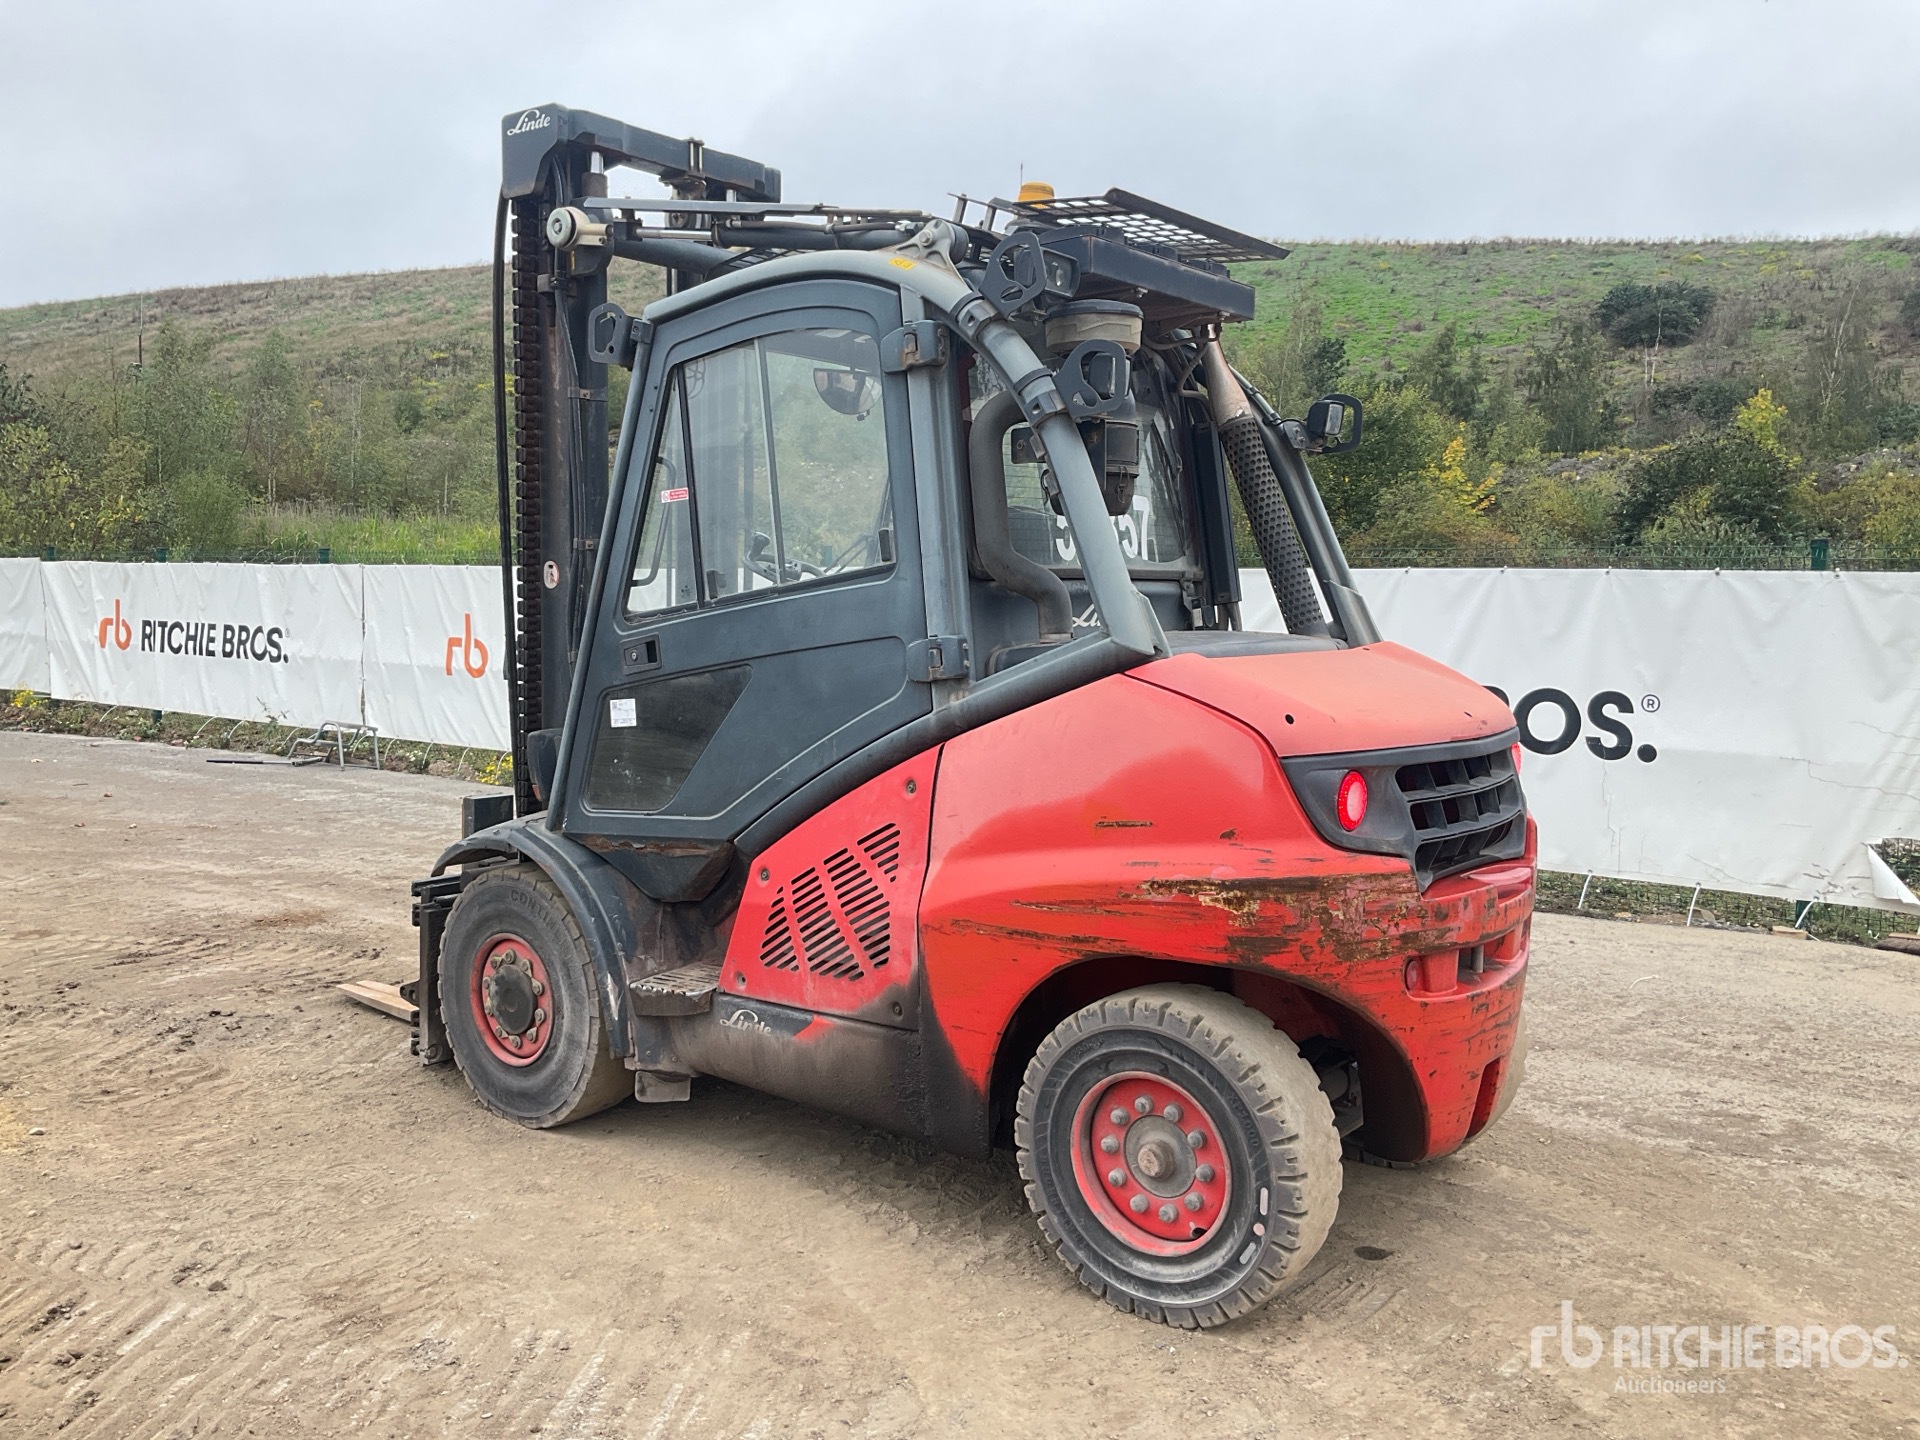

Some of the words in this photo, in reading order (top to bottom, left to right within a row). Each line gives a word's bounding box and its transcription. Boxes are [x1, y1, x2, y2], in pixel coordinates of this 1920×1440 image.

[507, 109, 551, 136] Linde
[141, 619, 217, 657] RITCHIE
[222, 623, 289, 664] BROS.
[1480, 686, 1658, 764] OS.
[719, 1009, 772, 1037] Linde
